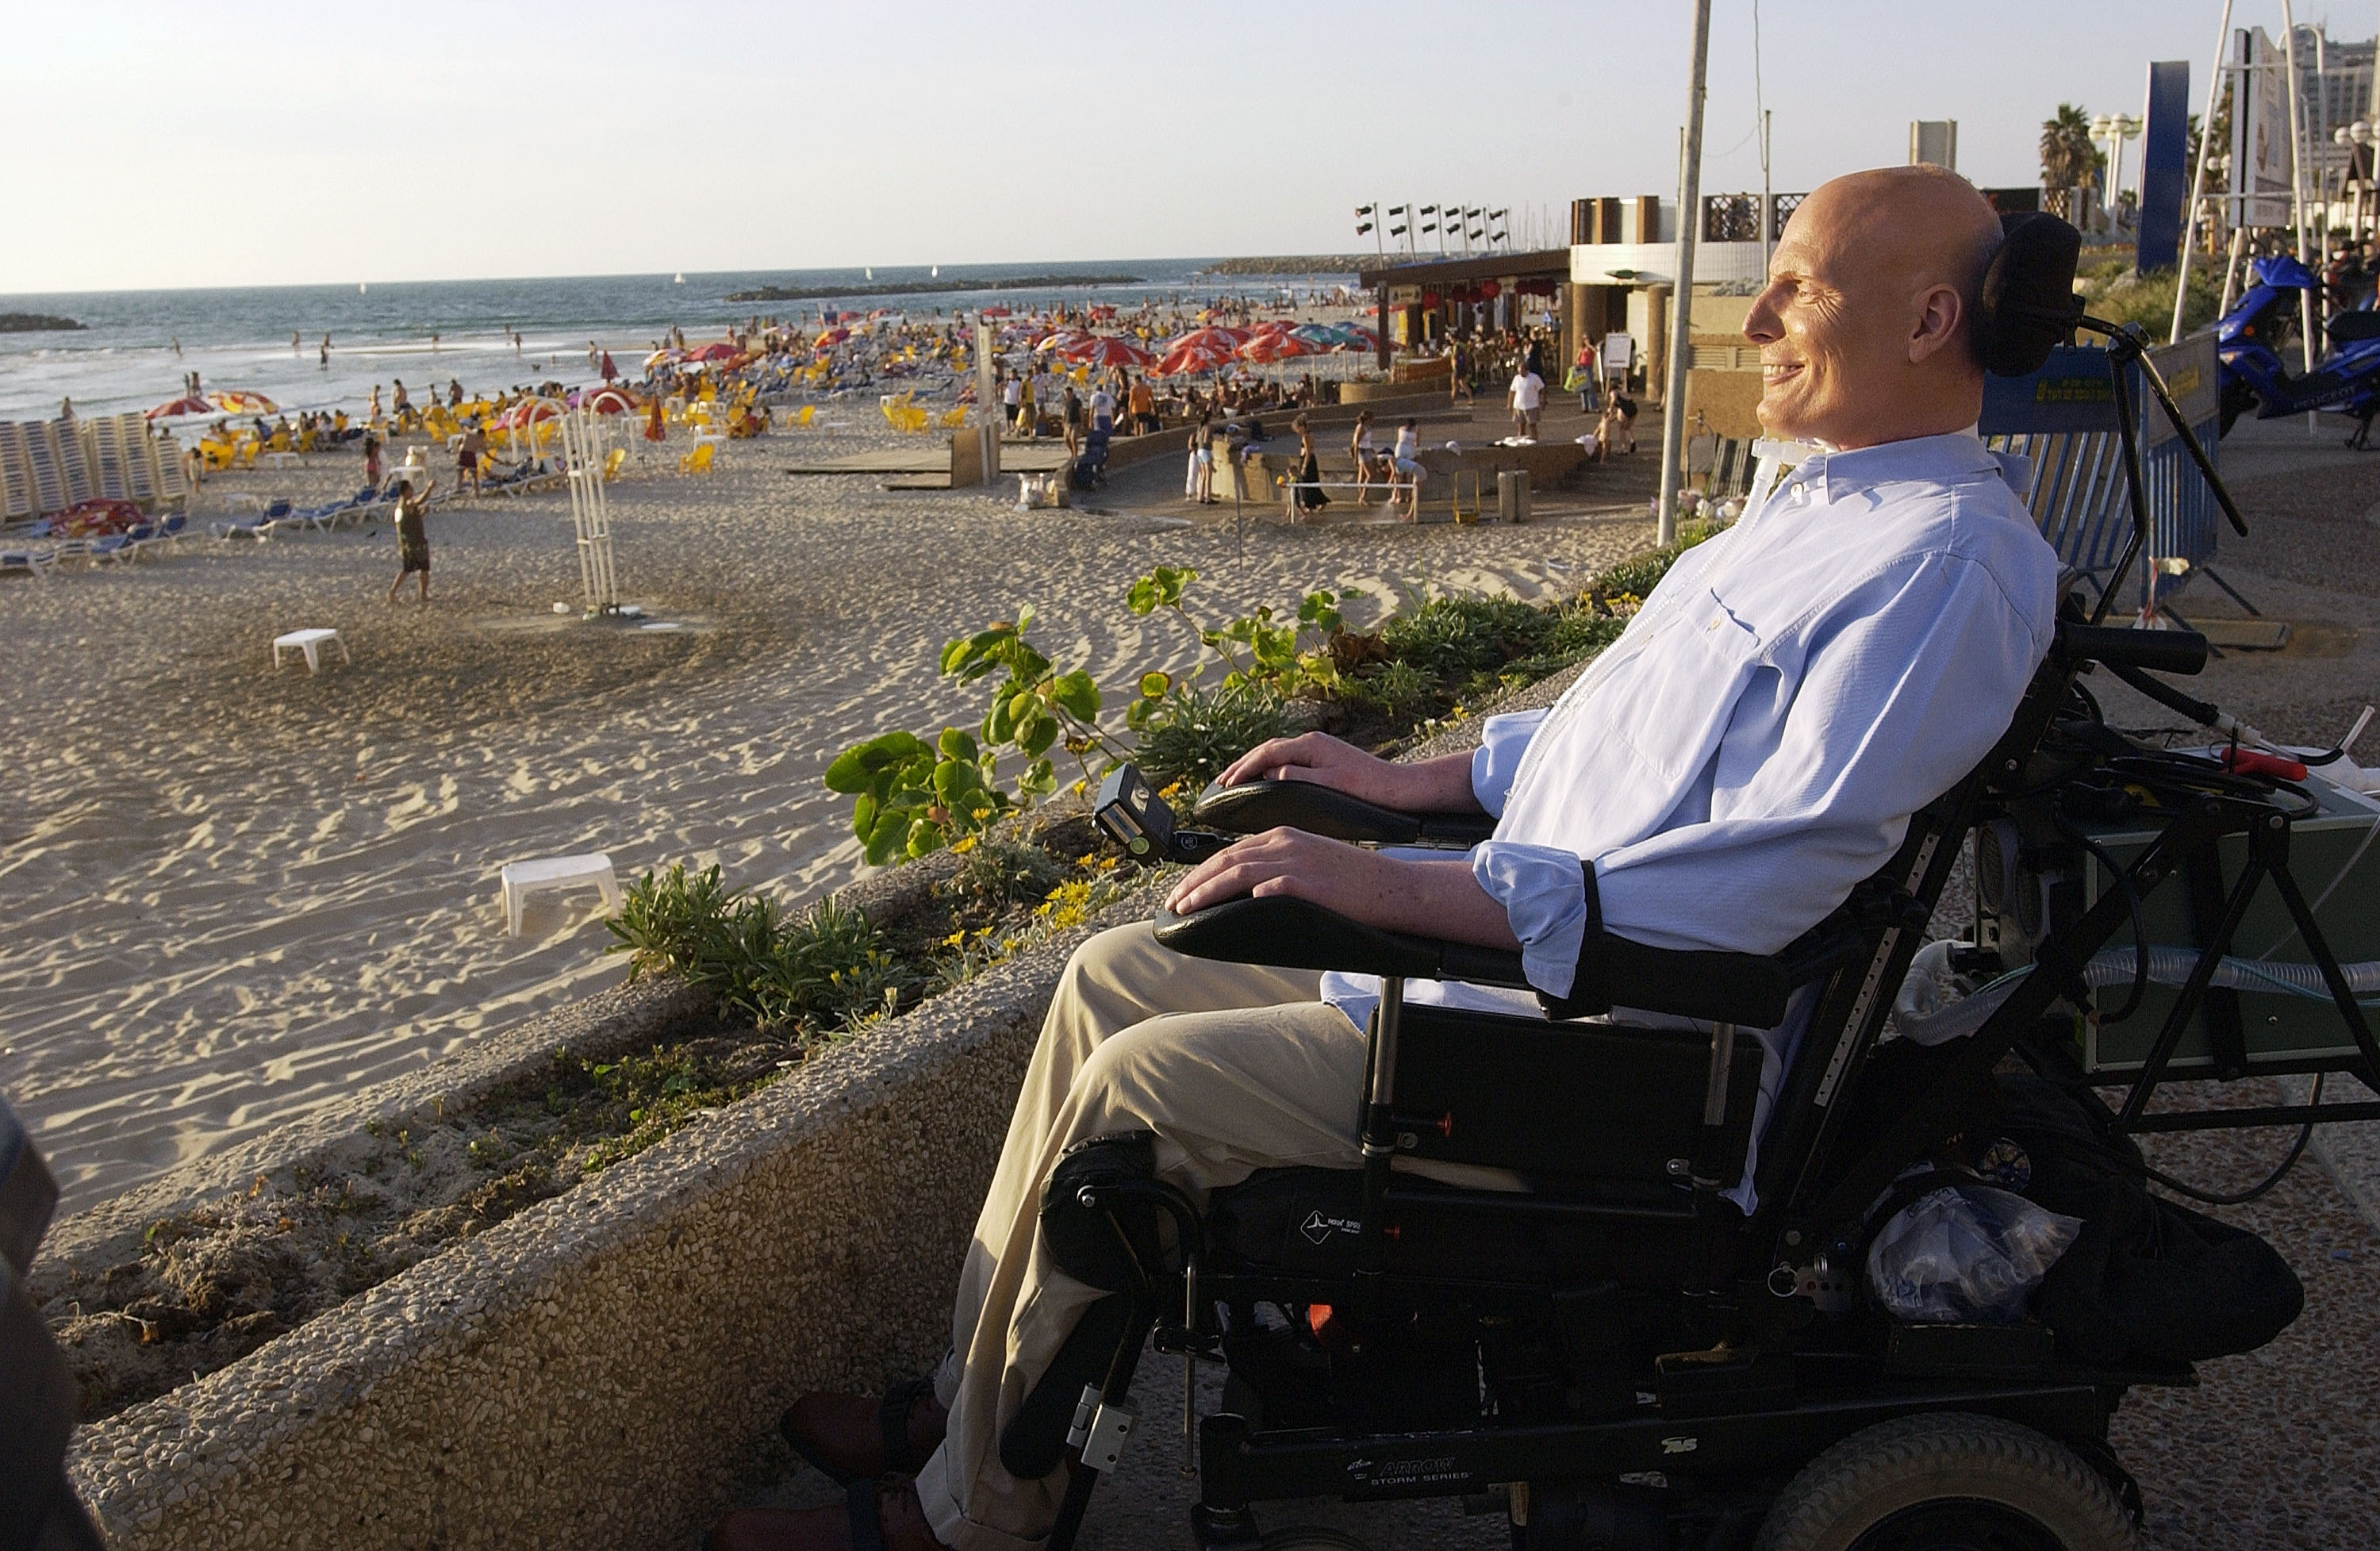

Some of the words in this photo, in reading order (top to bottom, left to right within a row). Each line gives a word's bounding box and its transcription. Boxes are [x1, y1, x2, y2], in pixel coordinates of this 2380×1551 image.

[1379, 1457, 1455, 1476] ARROW
[1371, 1476, 1416, 1486] STORM
[1422, 1472, 1469, 1482] SERIES
